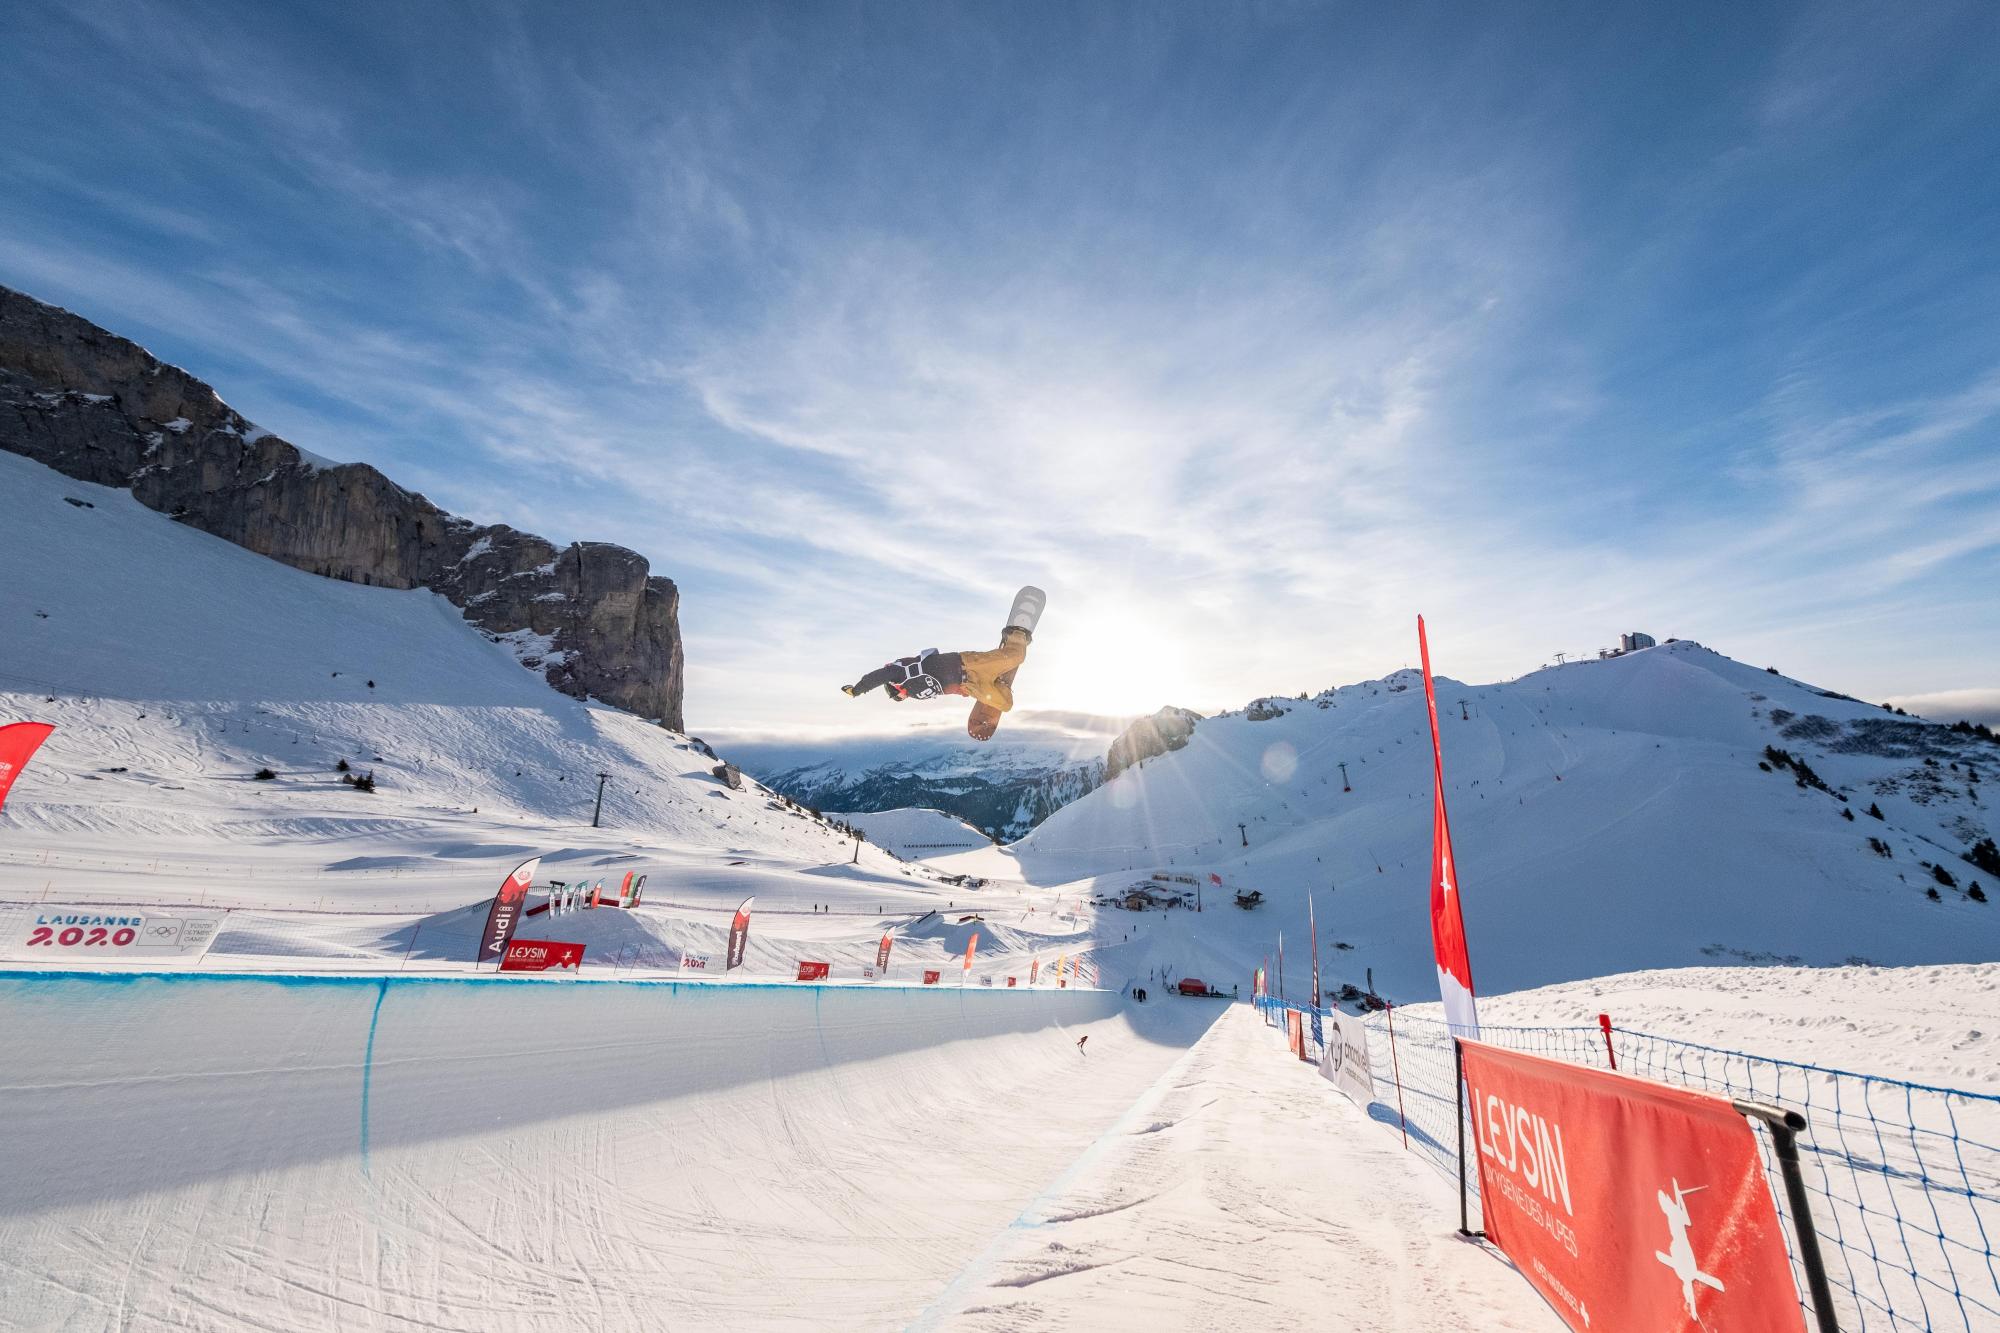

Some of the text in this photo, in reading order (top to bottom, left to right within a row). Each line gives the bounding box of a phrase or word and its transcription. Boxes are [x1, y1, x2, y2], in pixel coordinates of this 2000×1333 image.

[36, 915, 141, 926] LAUSANNE
[489, 913, 511, 953] Audi
[26, 927, 135, 946] 2020
[509, 947, 548, 959] LEYSIN
[1475, 1088, 1573, 1217] LEYSIN
[1524, 1194, 1544, 1226] DES
[1545, 1211, 1578, 1259] ALPES
